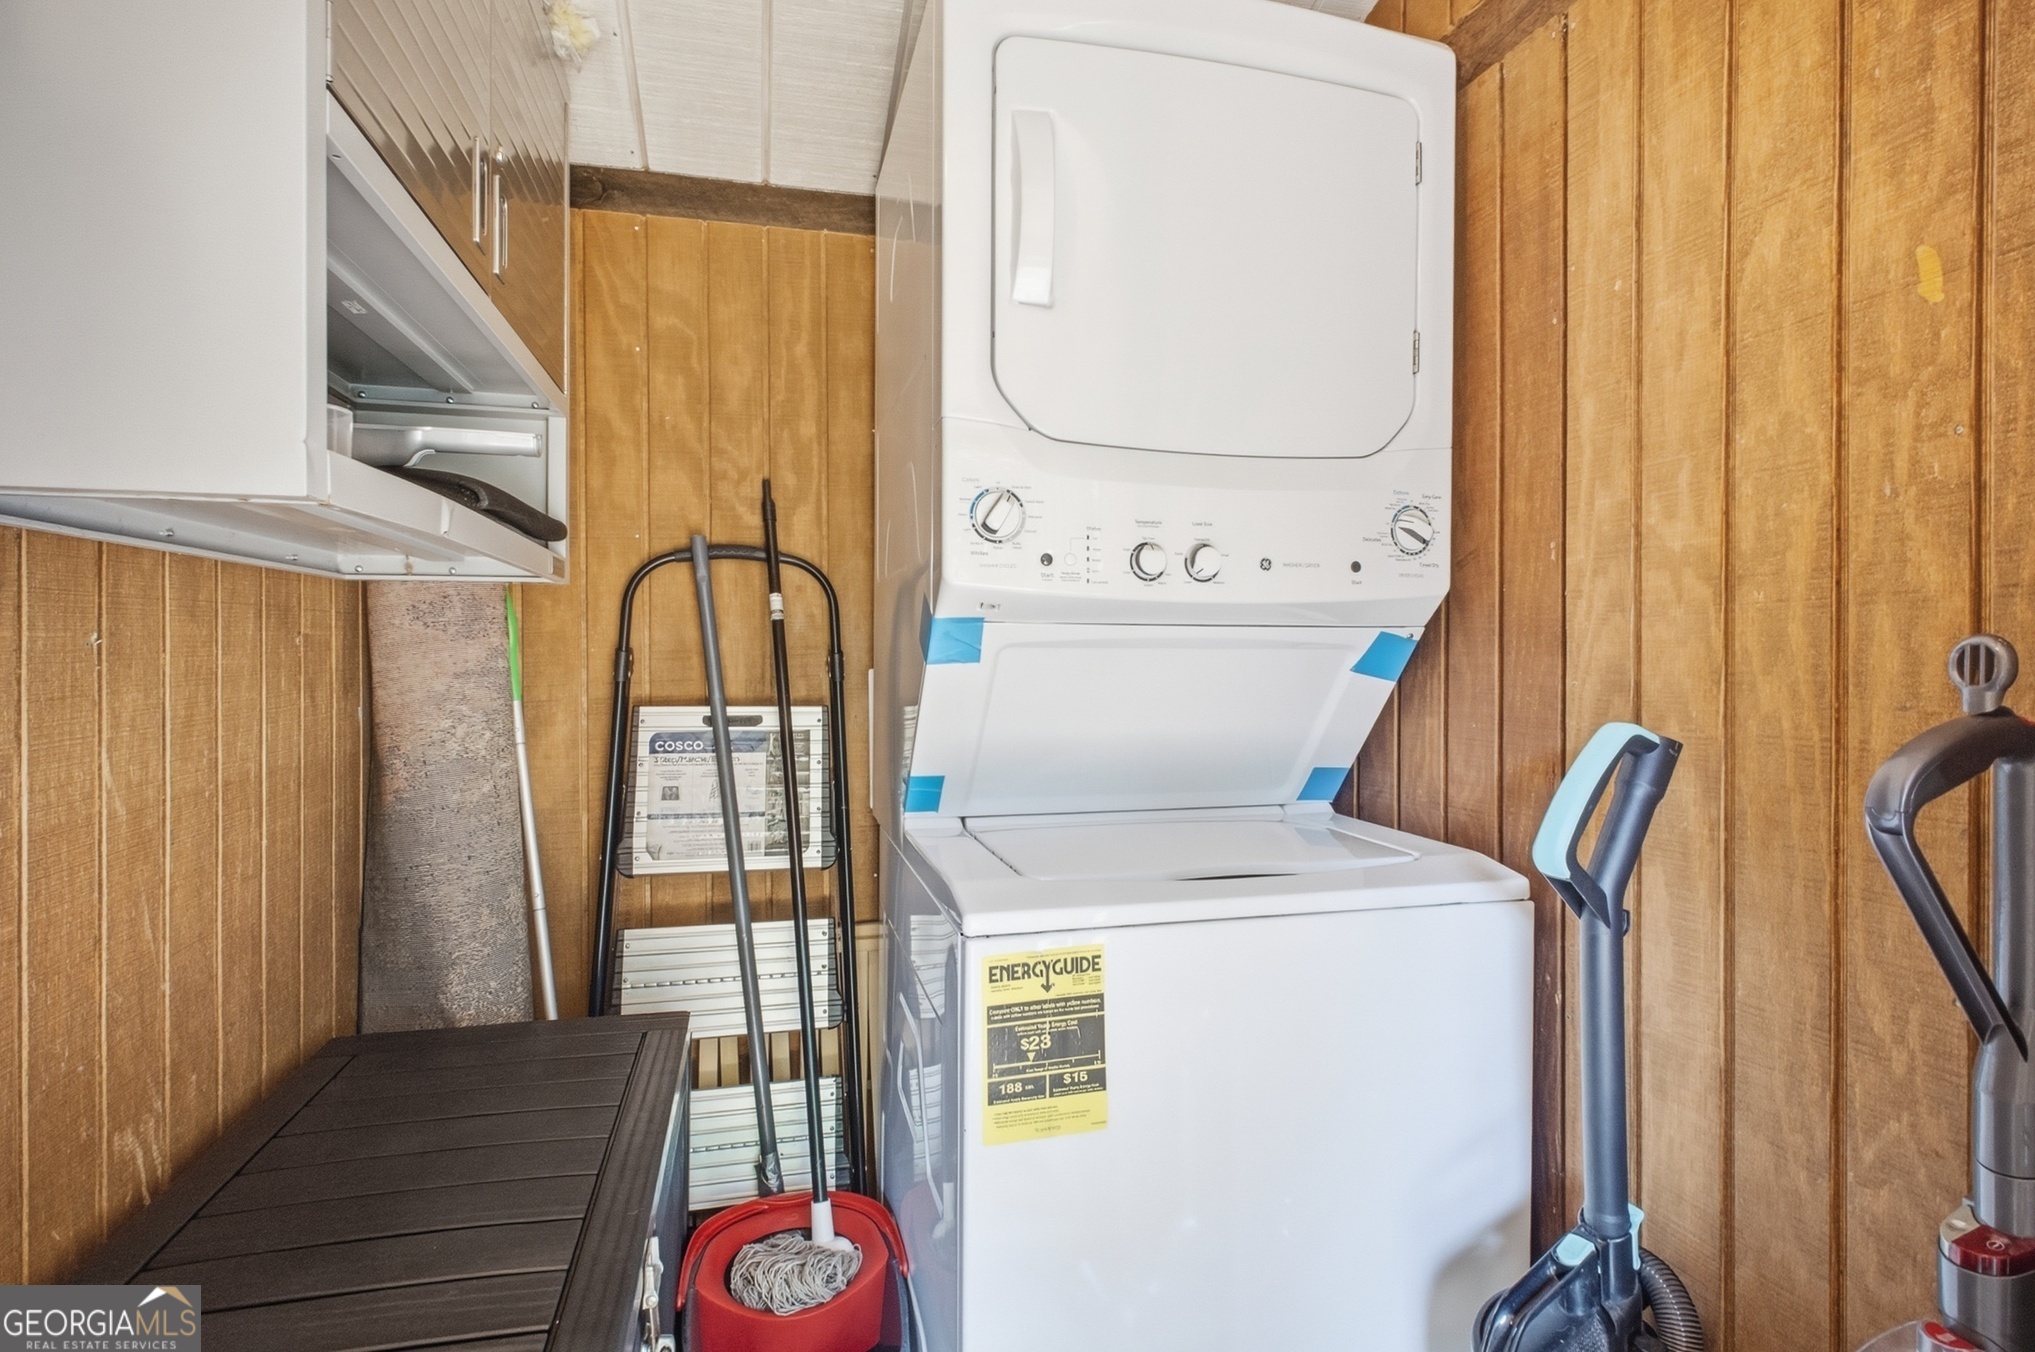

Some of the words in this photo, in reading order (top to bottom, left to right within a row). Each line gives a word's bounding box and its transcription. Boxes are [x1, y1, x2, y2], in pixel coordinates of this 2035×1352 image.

[655, 741, 703, 751] COSCO
[989, 955, 1102, 984] ENERGYGUIDE
[1066, 999, 1081, 1007] yellow
[1063, 1071, 1088, 1084] $15
[999, 1082, 1023, 1095] 188
